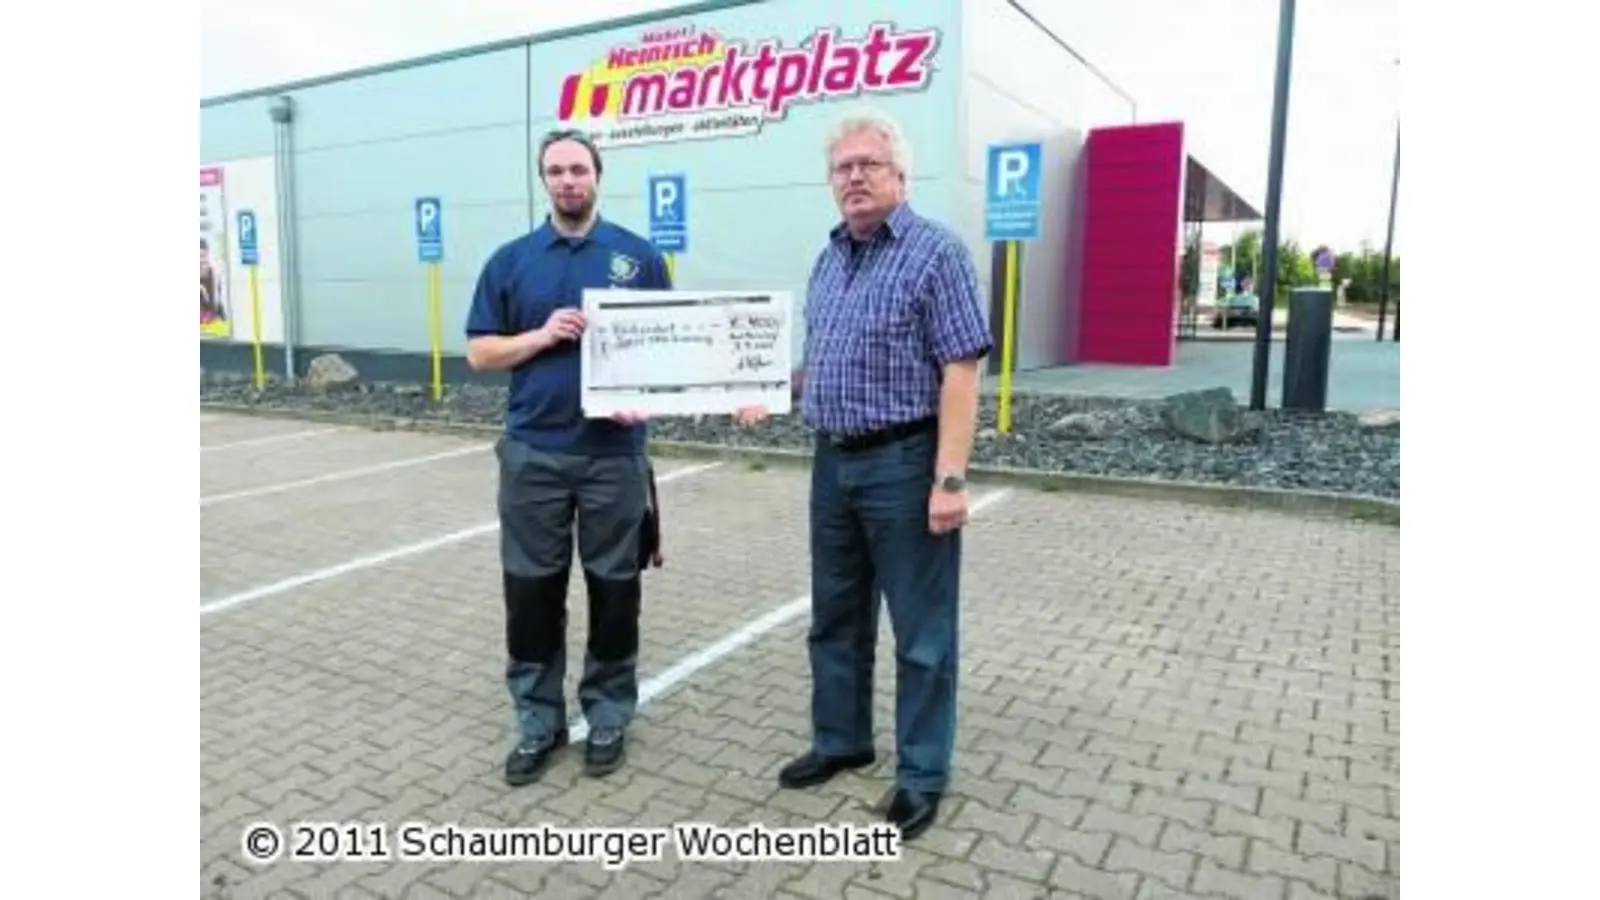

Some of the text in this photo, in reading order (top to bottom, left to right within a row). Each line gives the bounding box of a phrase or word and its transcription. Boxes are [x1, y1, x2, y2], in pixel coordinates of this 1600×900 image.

[622, 28, 933, 112] marktplatz
[998, 151, 1028, 197] P
[420, 201, 436, 234] P
[655, 181, 677, 218] P
[241, 215, 252, 241] P
